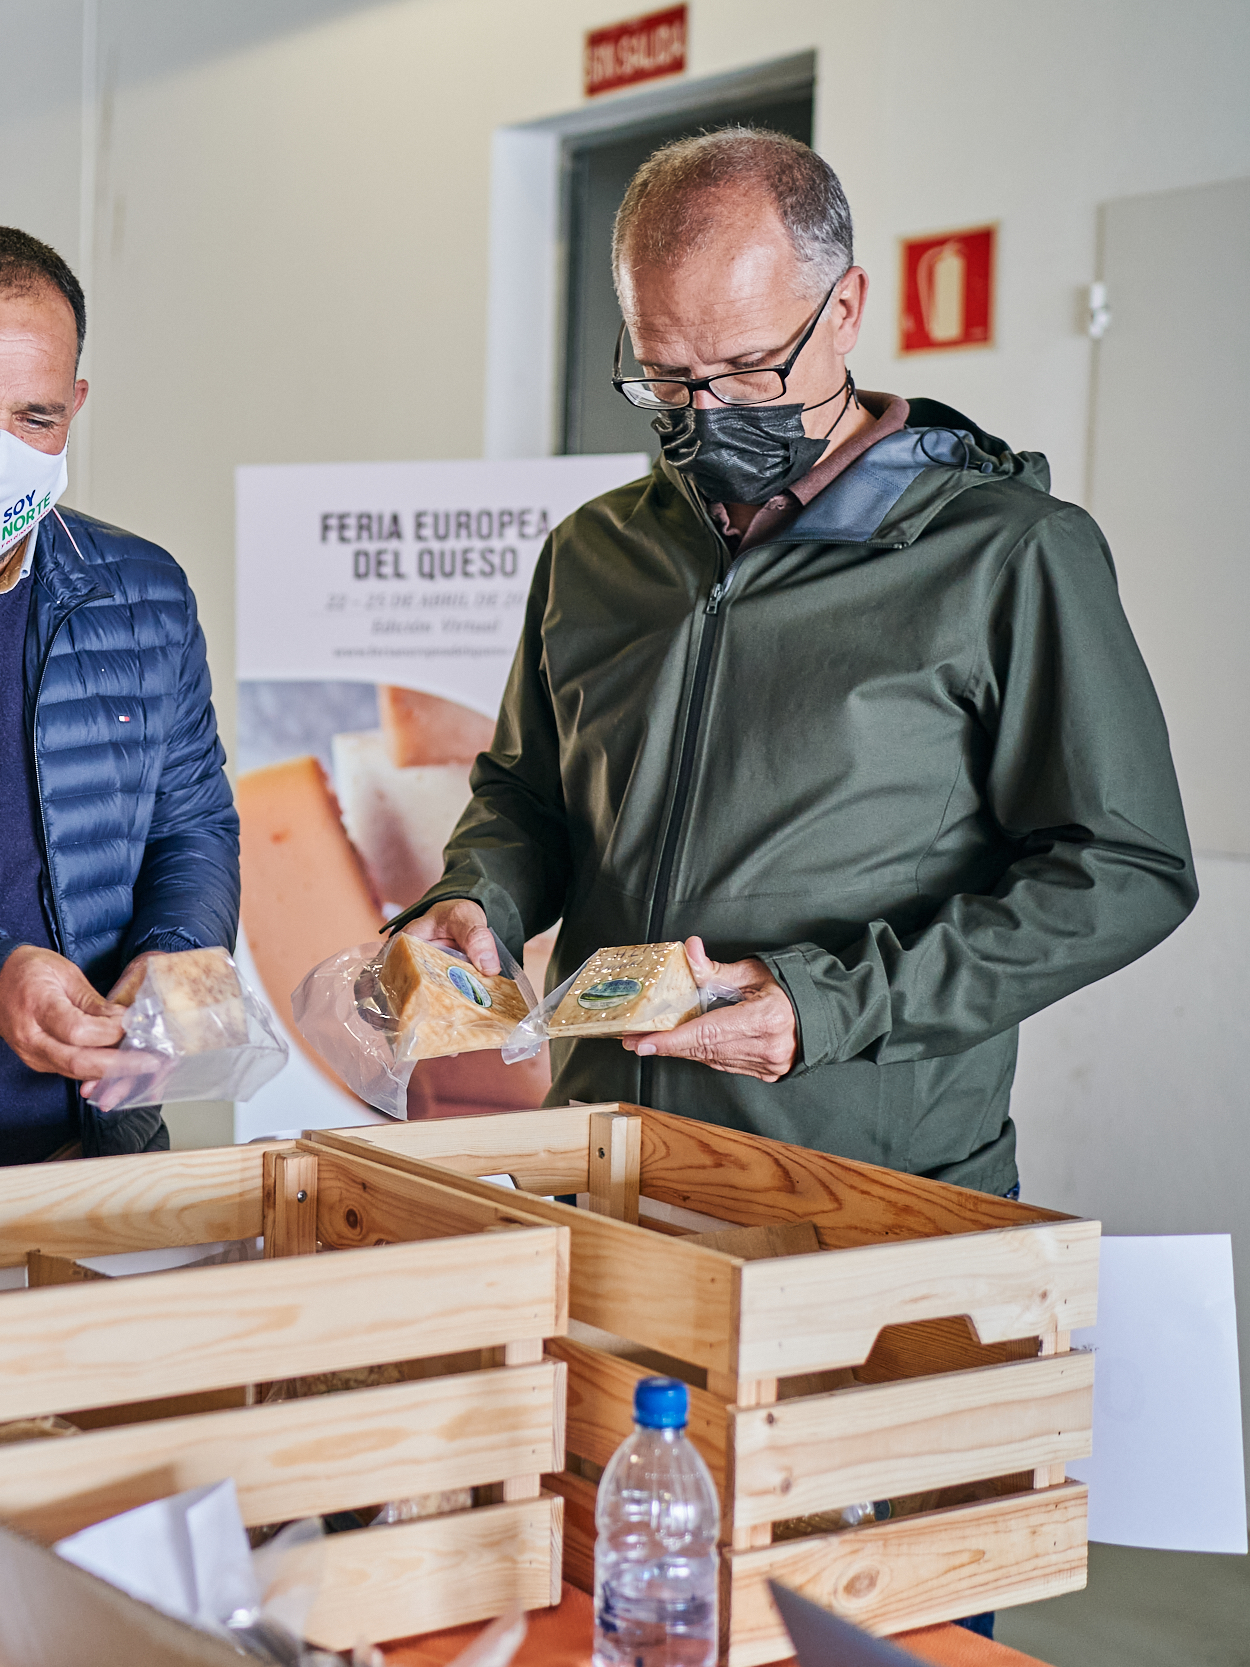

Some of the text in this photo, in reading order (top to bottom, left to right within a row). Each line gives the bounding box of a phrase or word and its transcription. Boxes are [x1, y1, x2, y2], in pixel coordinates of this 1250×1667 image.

[2, 490, 51, 541] NORTE
[3, 489, 36, 524] SOY
[320, 508, 549, 544] FERIA EUROPEA
[352, 546, 519, 581] DEL QUESO
[390, 590, 416, 609] DE
[418, 590, 471, 609] ABRIL
[474, 589, 500, 609] DE
